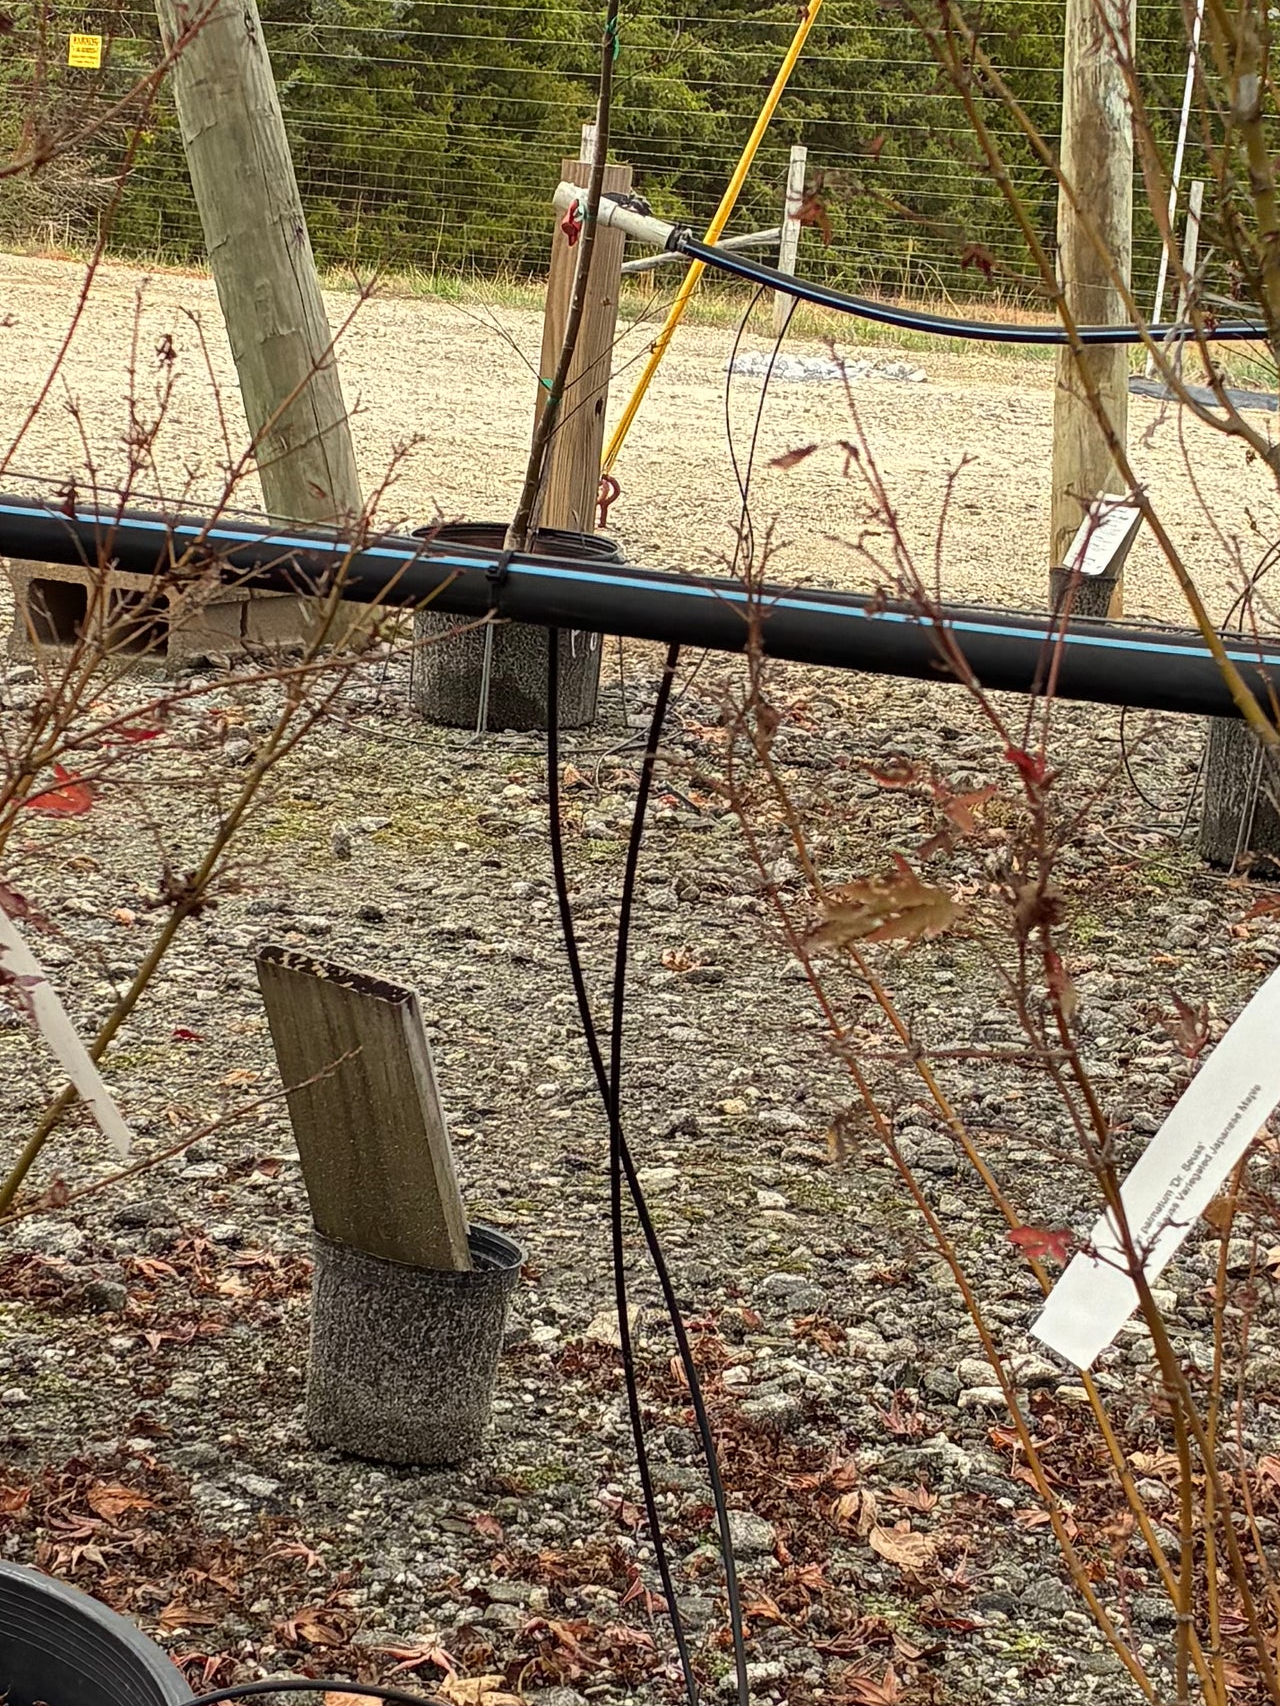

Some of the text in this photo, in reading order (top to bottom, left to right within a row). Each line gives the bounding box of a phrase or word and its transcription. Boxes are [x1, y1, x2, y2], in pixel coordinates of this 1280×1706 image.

[1174, 1153, 1214, 1201] Variegated
[1209, 1112, 1243, 1155] Japanese
[1237, 1084, 1262, 1113] Maple
